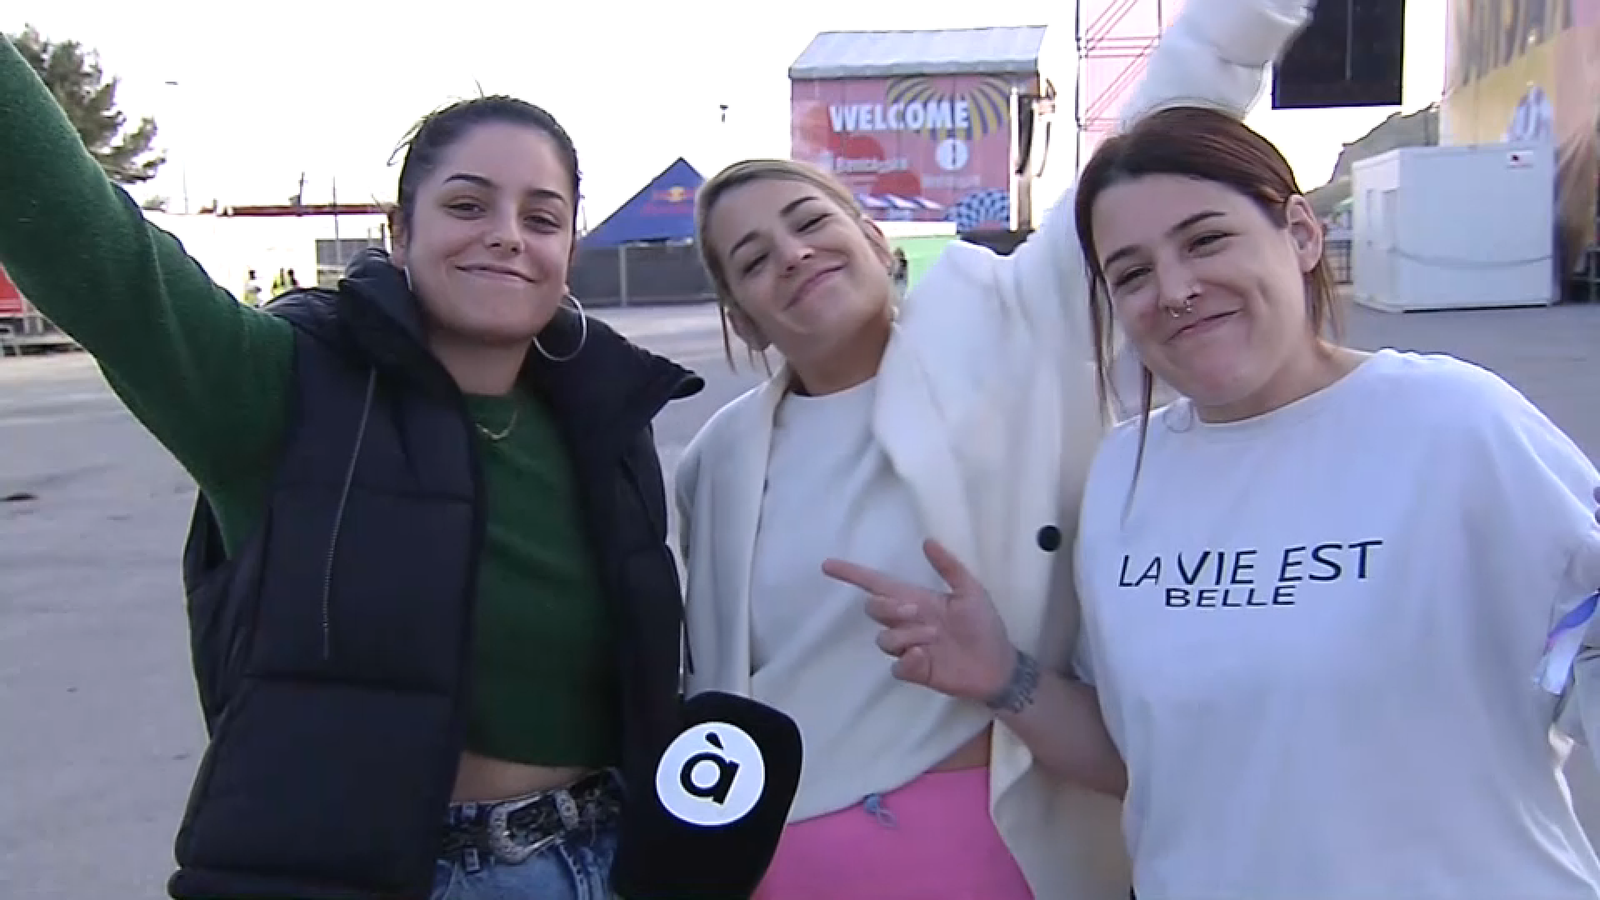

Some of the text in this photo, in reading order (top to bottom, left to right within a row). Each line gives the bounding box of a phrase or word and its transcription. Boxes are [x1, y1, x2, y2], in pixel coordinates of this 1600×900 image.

[829, 101, 970, 133] WELCOME
[1118, 540, 1384, 588] LA VIE EST
[1165, 585, 1297, 608] BELLE
